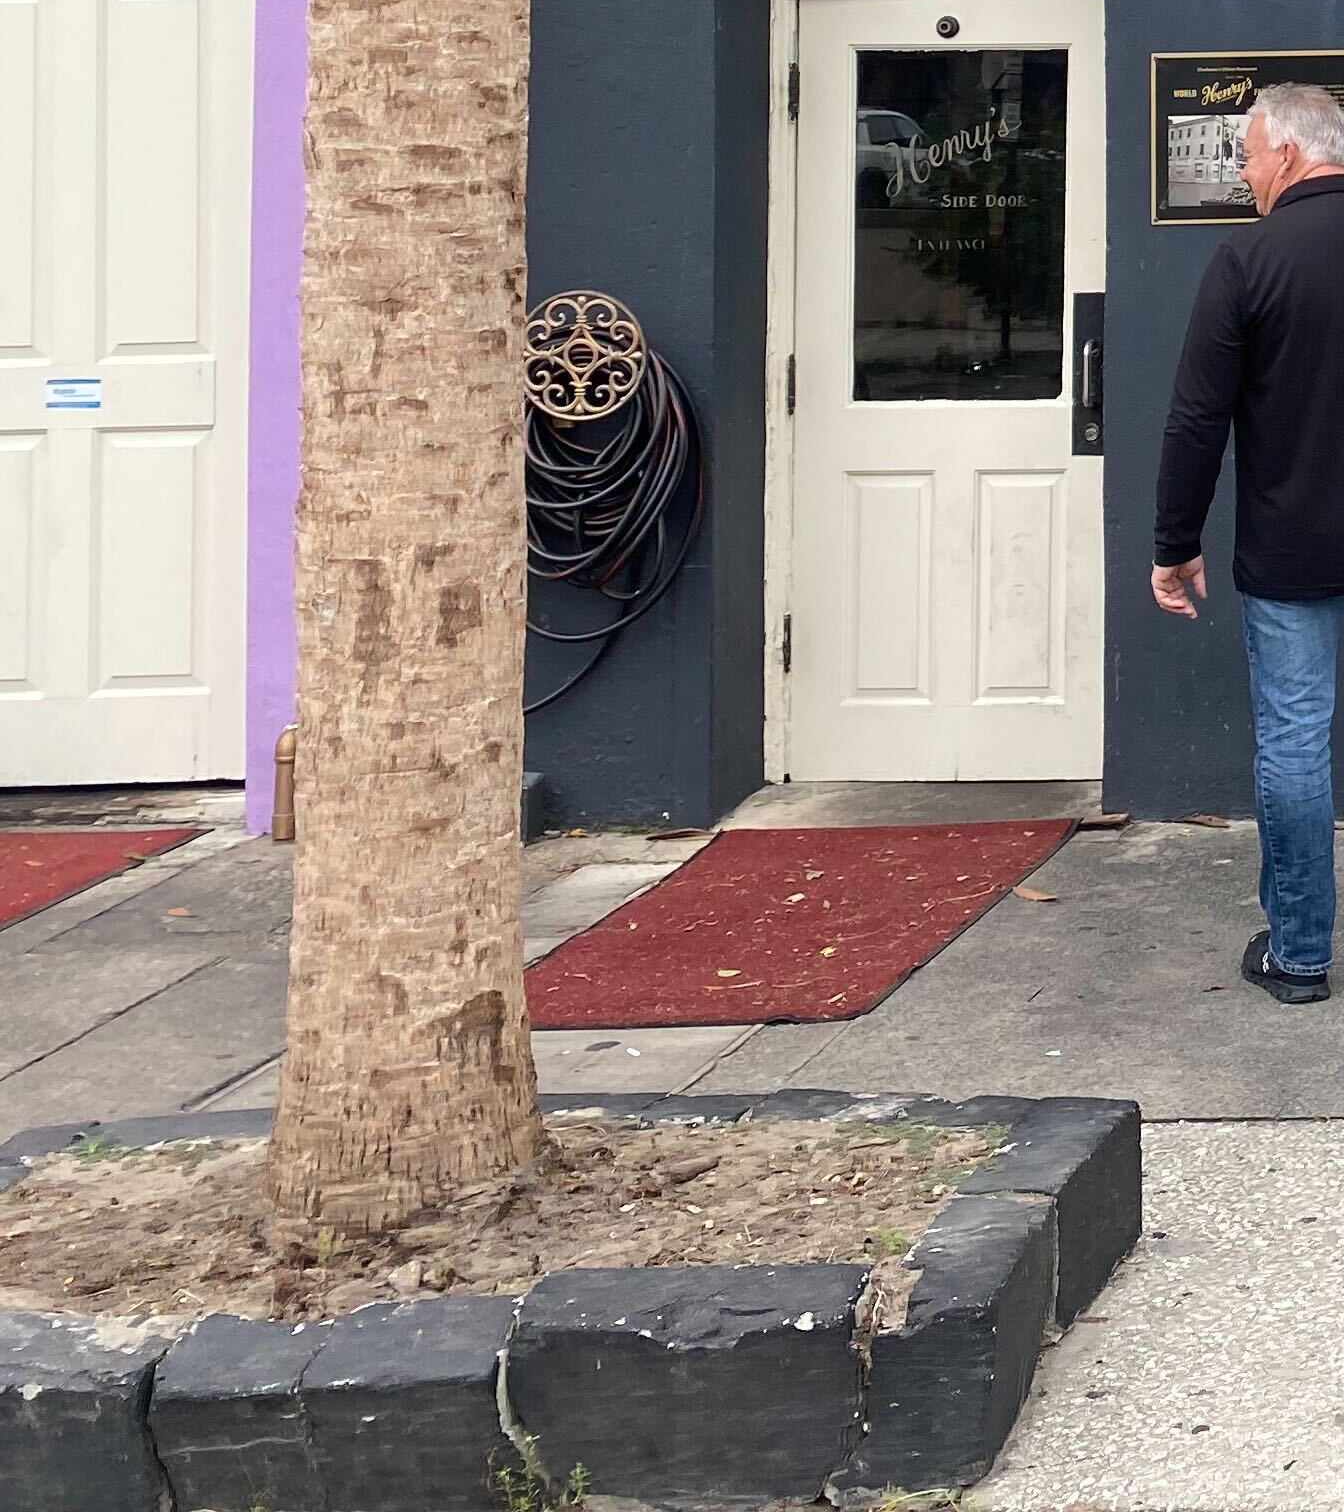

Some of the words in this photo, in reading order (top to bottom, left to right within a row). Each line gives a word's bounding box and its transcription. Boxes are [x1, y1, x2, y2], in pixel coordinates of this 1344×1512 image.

[885, 106, 1023, 198] Henry's
[940, 193, 978, 208] SIDE
[985, 194, 1028, 208] DOOR
